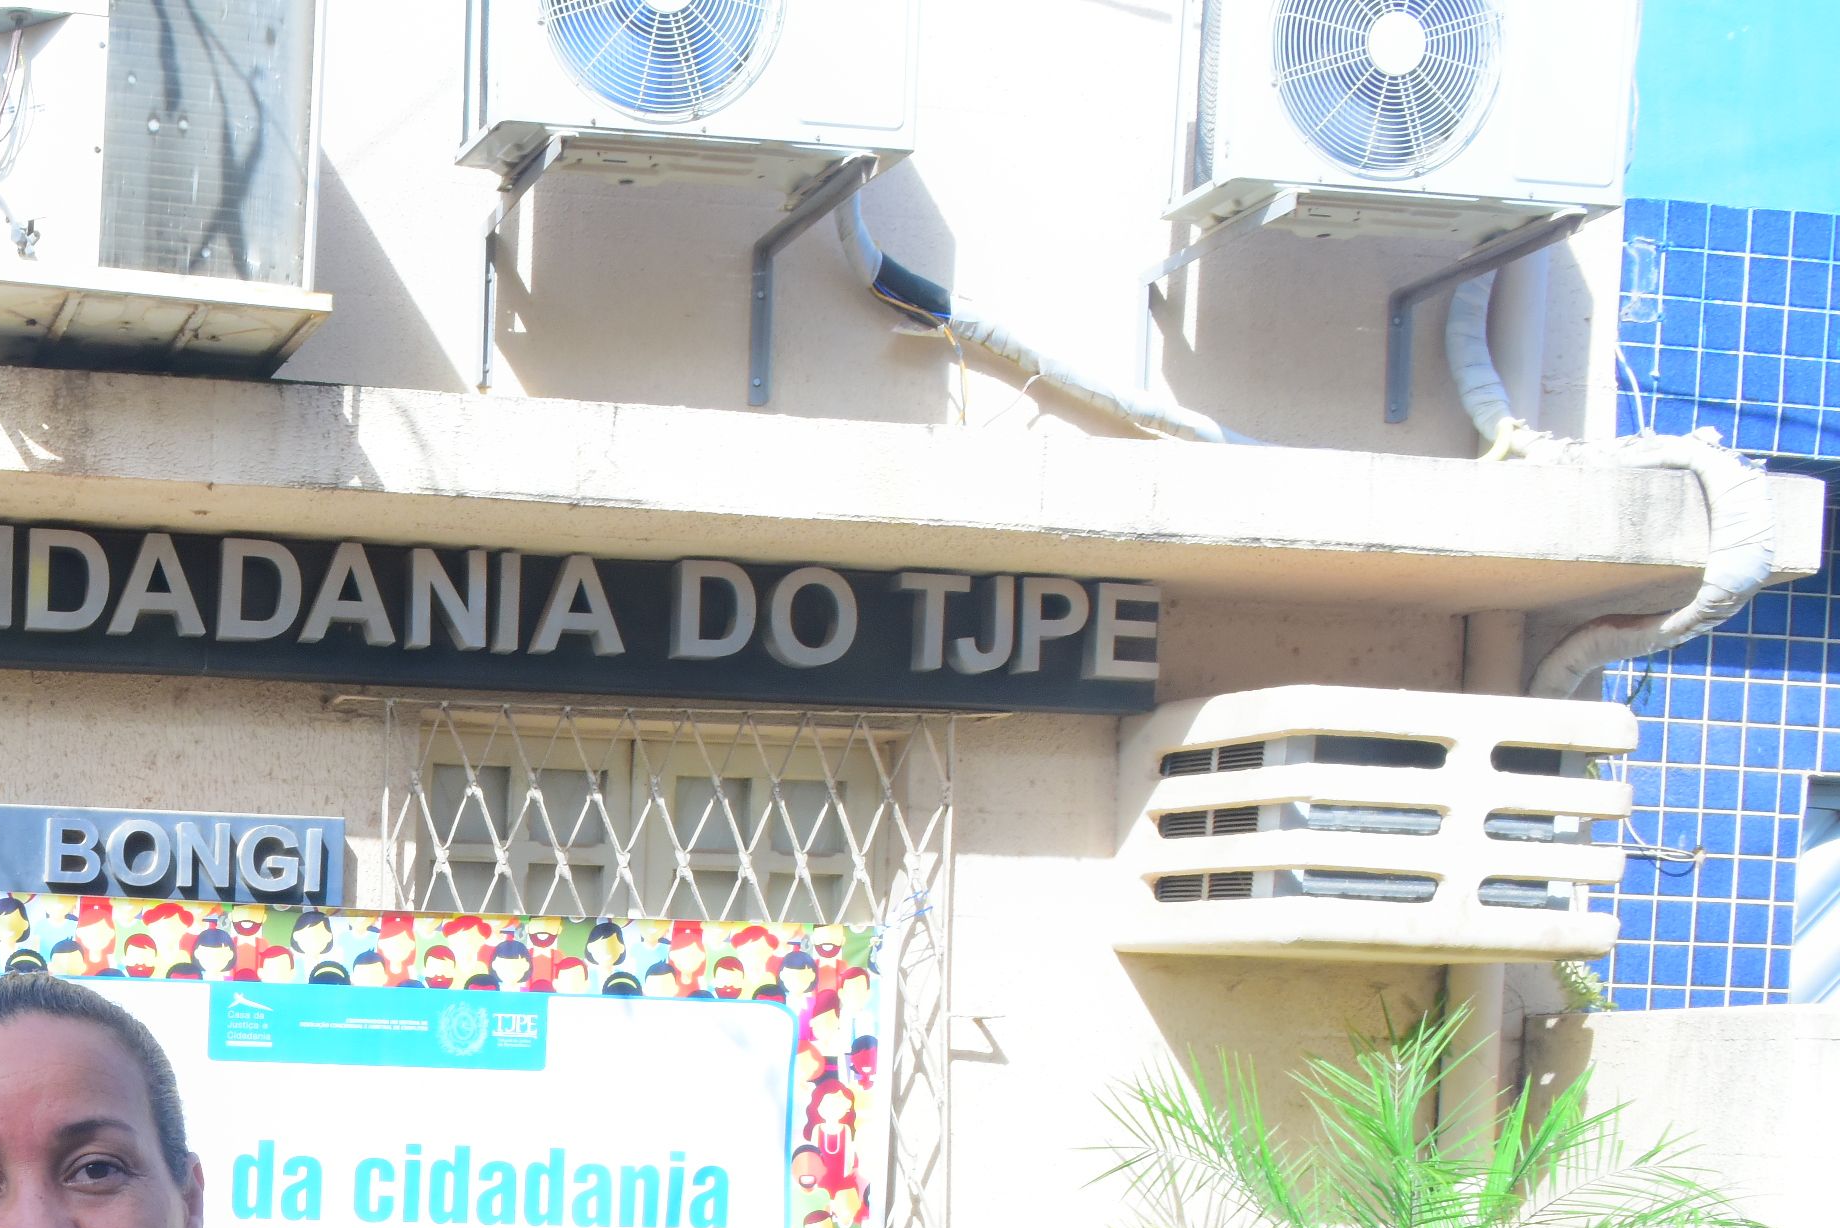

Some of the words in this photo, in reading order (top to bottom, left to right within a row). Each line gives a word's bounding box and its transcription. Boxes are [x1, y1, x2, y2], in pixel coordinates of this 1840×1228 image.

[667, 558, 858, 668] DO
[892, 572, 1160, 682] TJPE
[43, 816, 324, 893] BONGI
[493, 1013, 538, 1034] TJPE
[231, 1139, 323, 1224] da
